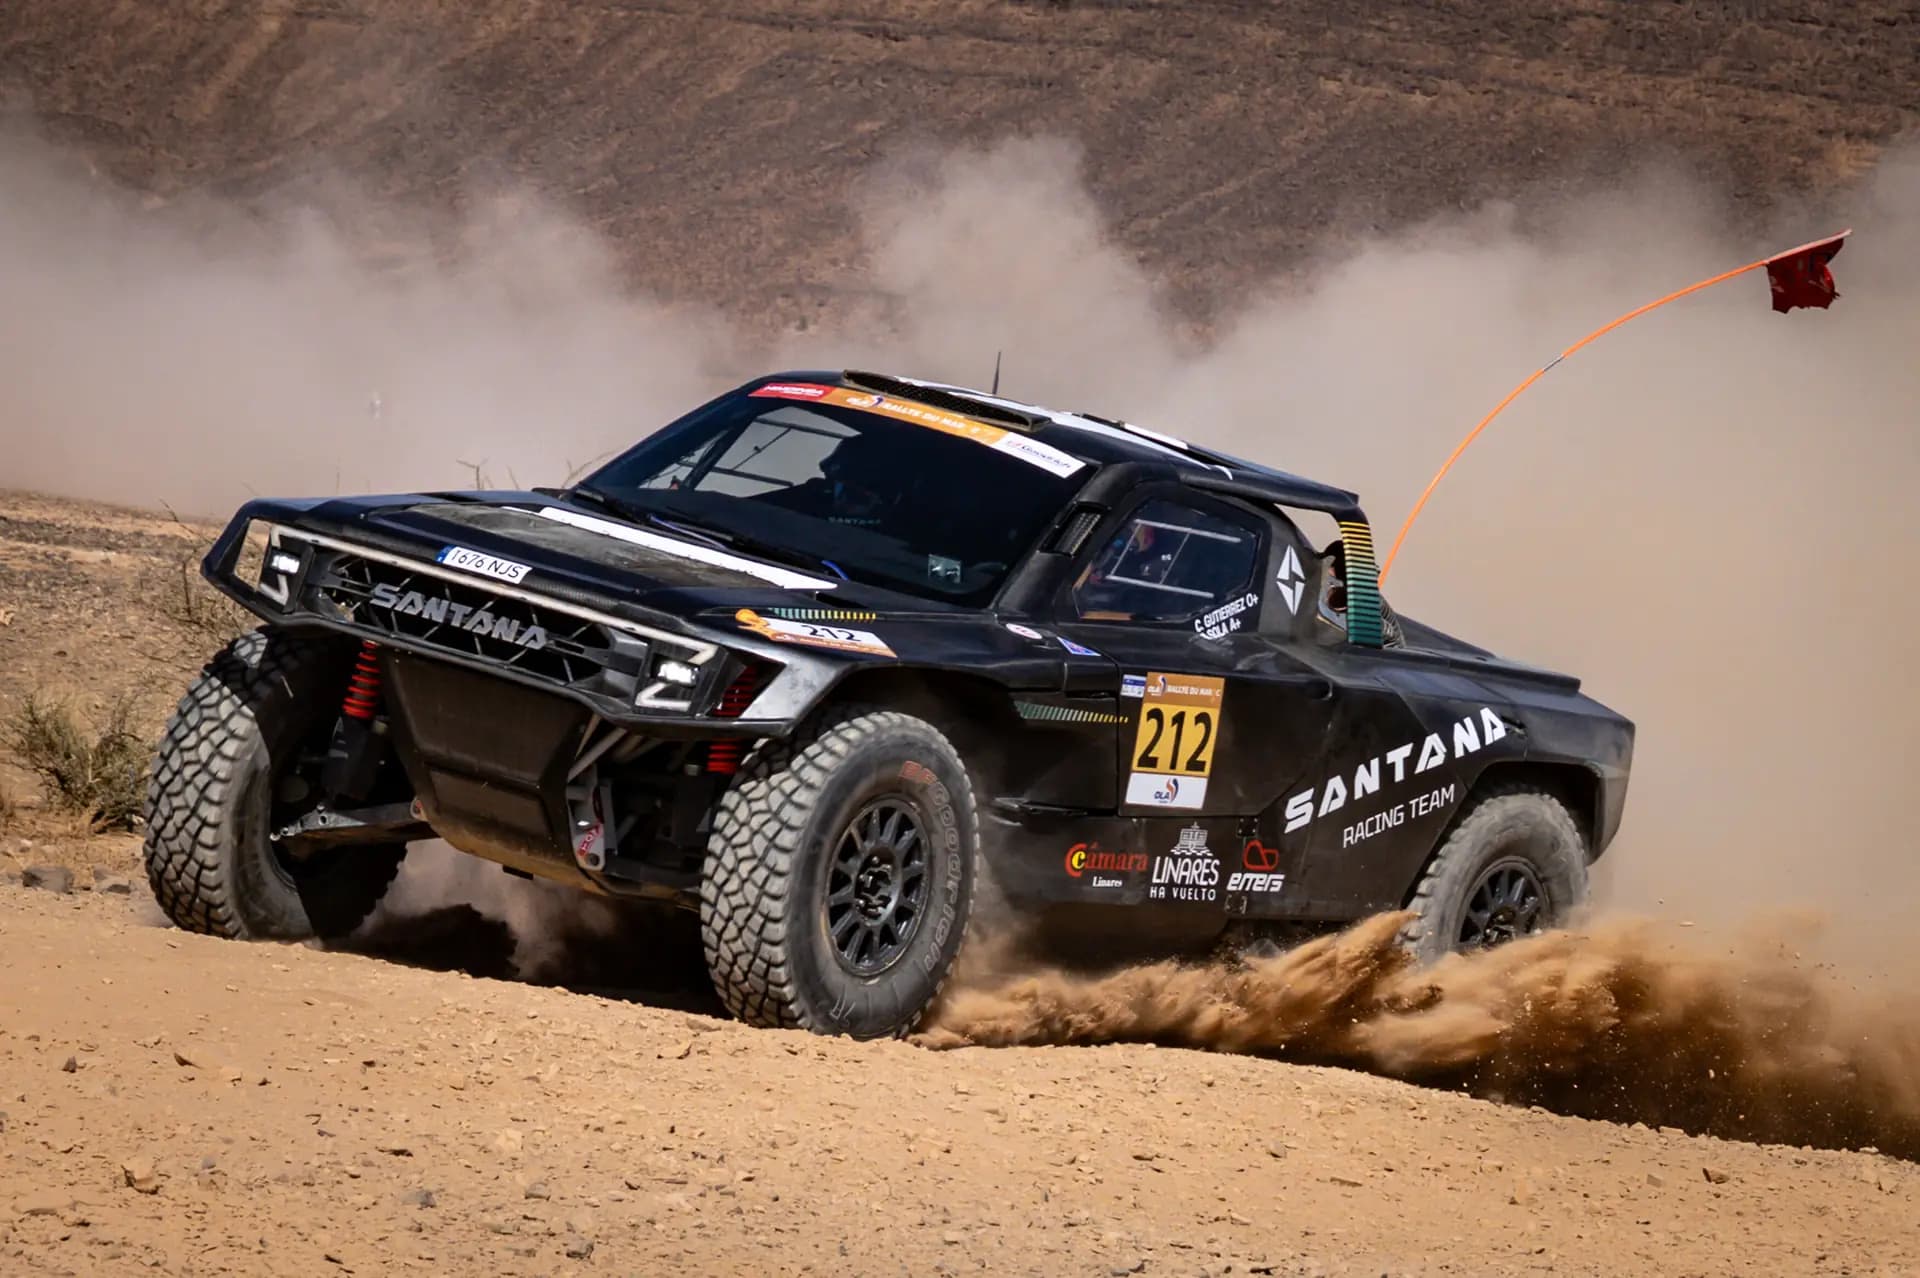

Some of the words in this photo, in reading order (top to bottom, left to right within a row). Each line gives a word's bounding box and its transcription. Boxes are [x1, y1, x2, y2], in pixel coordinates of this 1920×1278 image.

[451, 549, 485, 571] 1676
[489, 560, 521, 580] NJS
[369, 582, 549, 651] SANTANA
[1203, 597, 1246, 628] GUTIERREZ
[802, 624, 861, 642] 212
[1137, 707, 1212, 773] 212
[1284, 707, 1507, 834] SANTANA
[1343, 804, 1404, 848] RACING
[1409, 783, 1455, 819] TEAM
[1092, 876, 1123, 888] Linares
[1151, 856, 1220, 886] LINARES
[1150, 886, 1166, 899] HA
[1172, 887, 1217, 901] VUELTO
